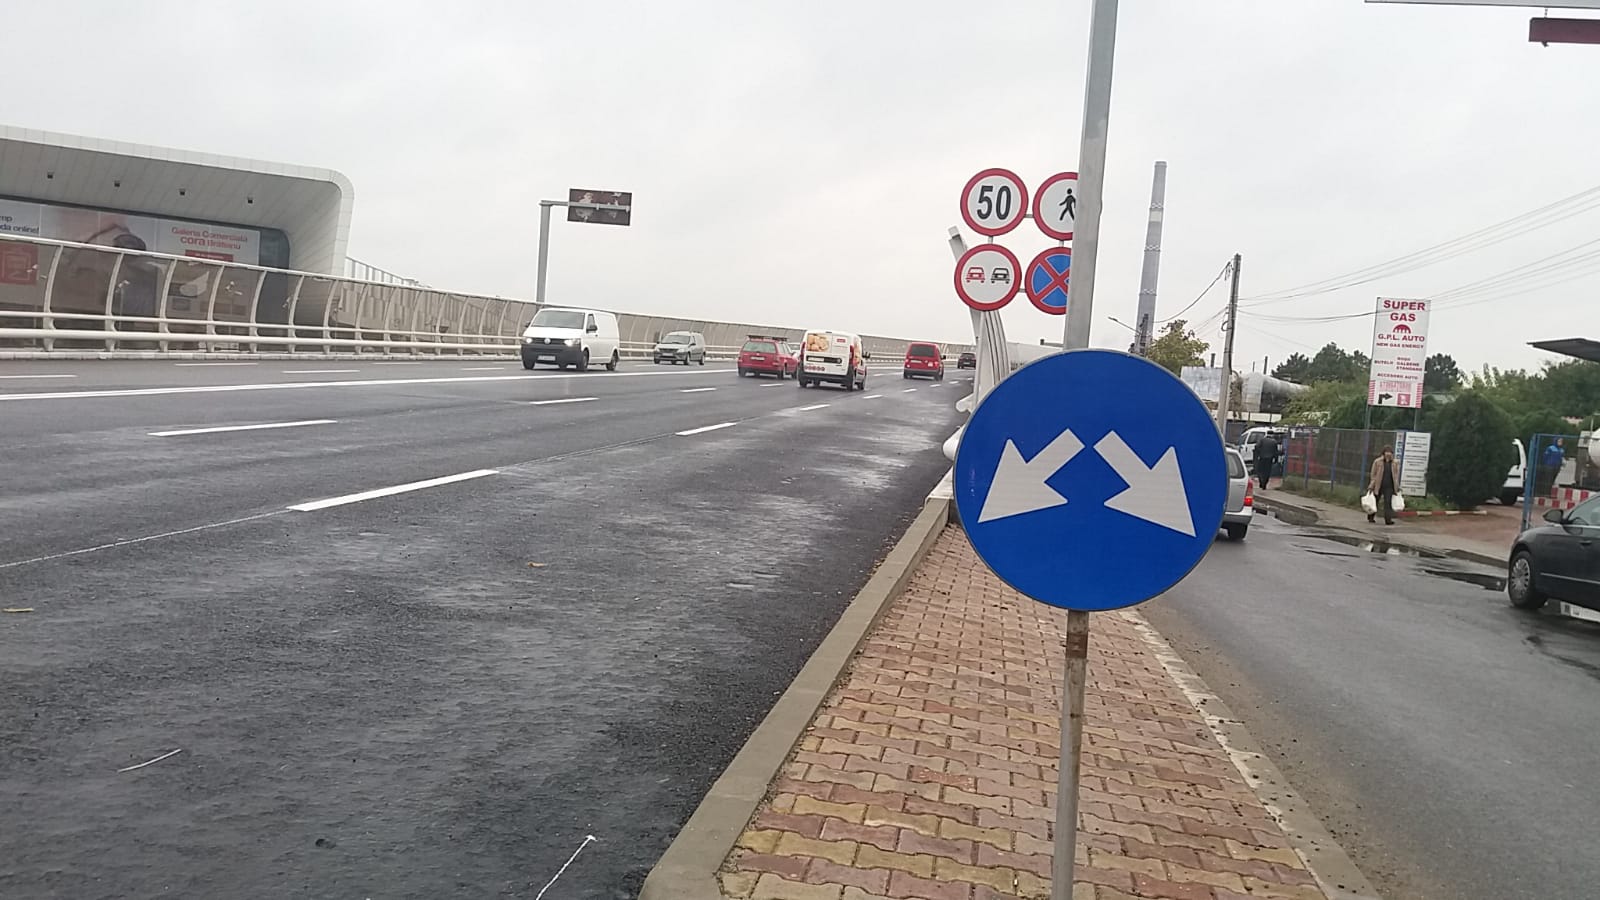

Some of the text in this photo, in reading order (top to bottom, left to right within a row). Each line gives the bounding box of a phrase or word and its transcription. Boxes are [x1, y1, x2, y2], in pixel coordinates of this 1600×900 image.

[977, 185, 1012, 220] 50
[180, 236, 206, 246] cora
[1383, 300, 1425, 311] SUPER
[1390, 312, 1416, 322] GAS
[1378, 333, 1400, 341] G.P.L.
